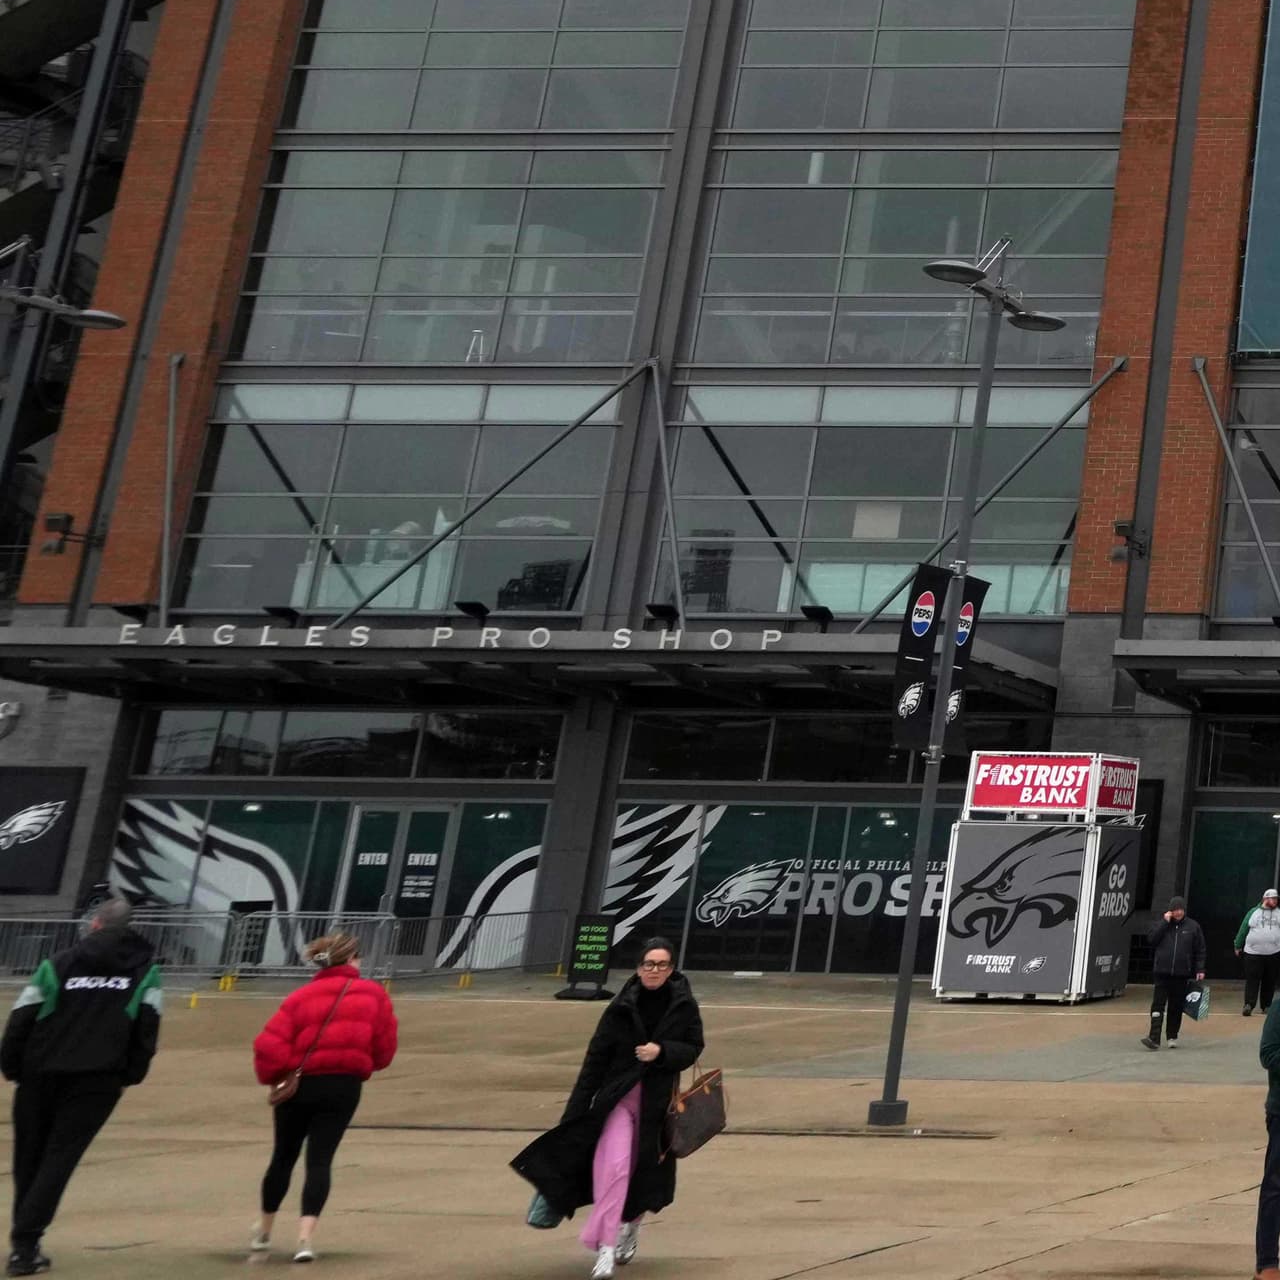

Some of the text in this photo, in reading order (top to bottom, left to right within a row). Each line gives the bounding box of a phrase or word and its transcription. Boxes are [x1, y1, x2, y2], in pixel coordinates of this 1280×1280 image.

[914, 606, 932, 620] PEPSI
[119, 623, 782, 651] EAGLES PRO SHOP
[976, 764, 1090, 786] FIRSTRUST
[1100, 765, 1136, 789] FIRSTRUST
[1020, 787, 1080, 803] BANK
[1113, 789, 1133, 806] BANK
[358, 853, 388, 865] ENTER
[407, 853, 438, 866] ENTER
[794, 859, 860, 870] OFICIAL
[1109, 864, 1127, 889] GO
[768, 873, 883, 916] PRO
[1099, 892, 1130, 917] BIRDS
[966, 954, 1016, 966] FIRSTRUST
[985, 965, 1011, 973] BANK
